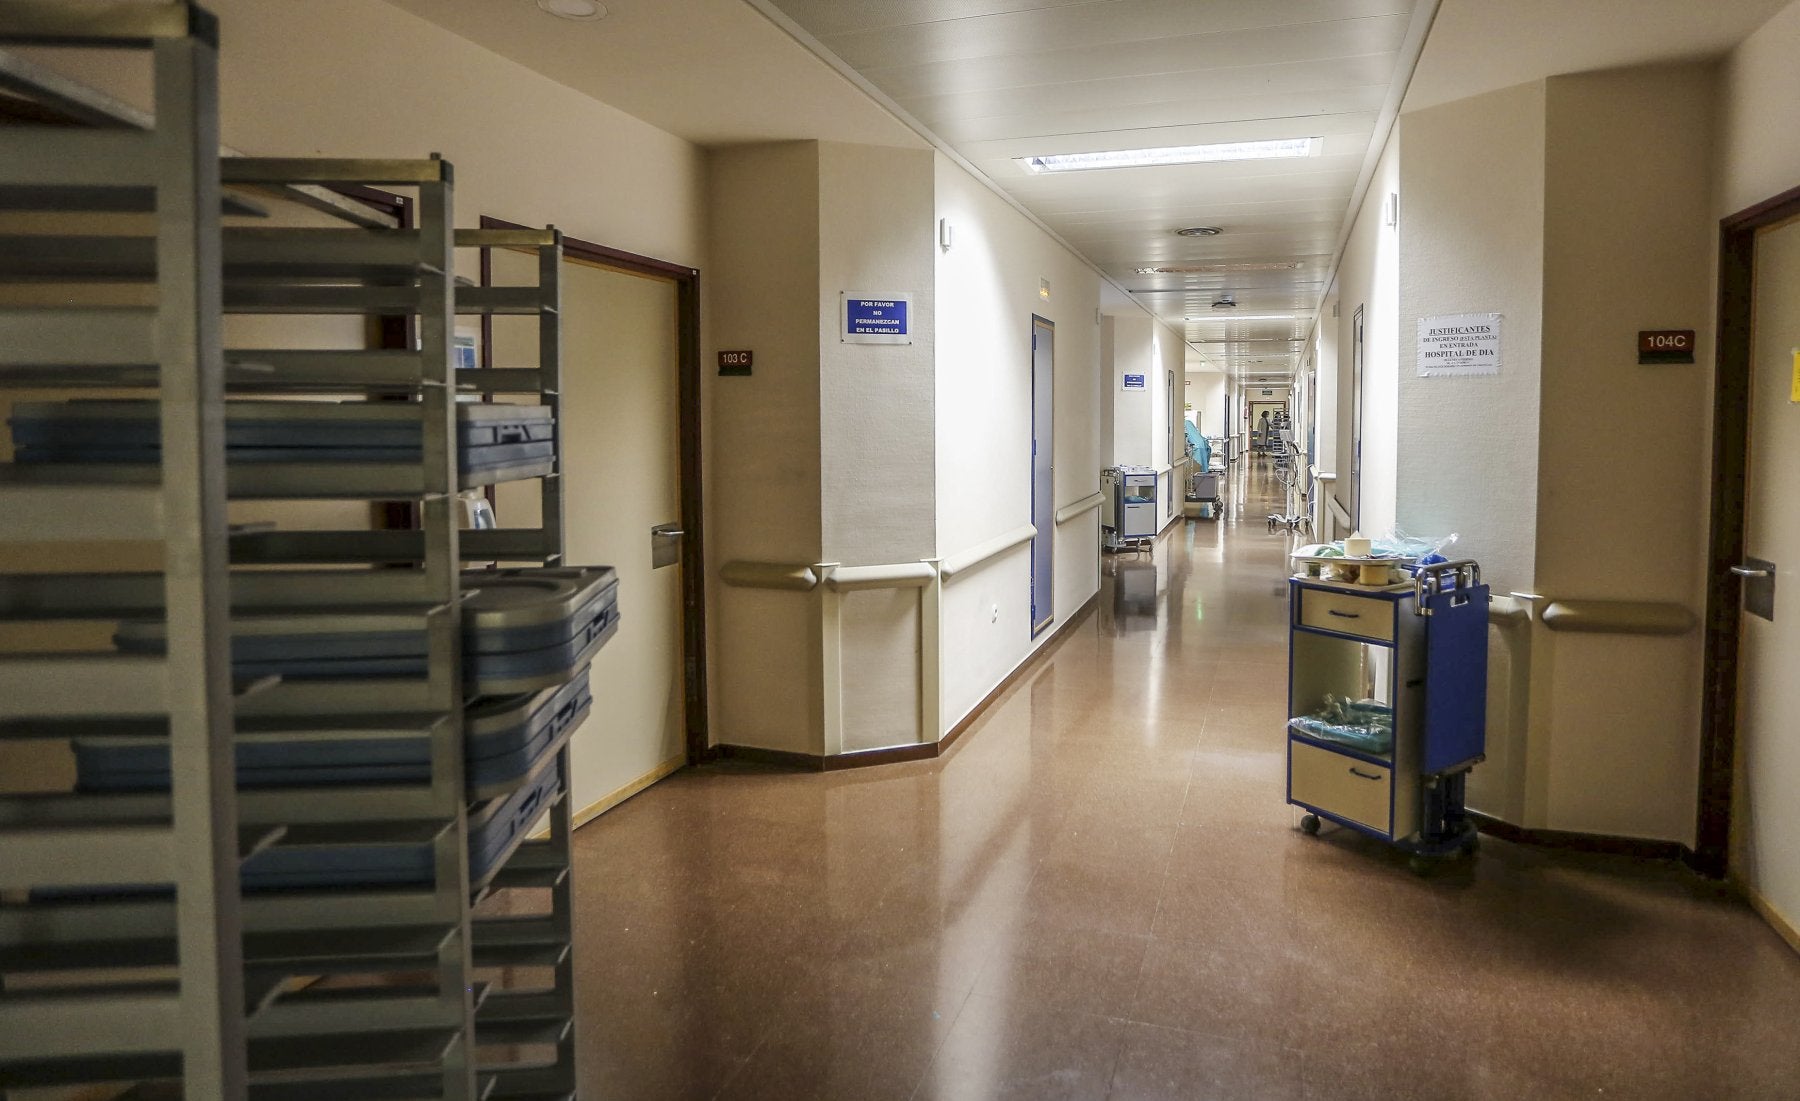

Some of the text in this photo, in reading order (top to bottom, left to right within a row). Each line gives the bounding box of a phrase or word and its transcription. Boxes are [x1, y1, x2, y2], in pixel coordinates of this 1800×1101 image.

[1429, 326, 1491, 335] JUSTIFICANTES
[1647, 335, 1686, 347] 104C
[723, 352, 747, 363] 103 C
